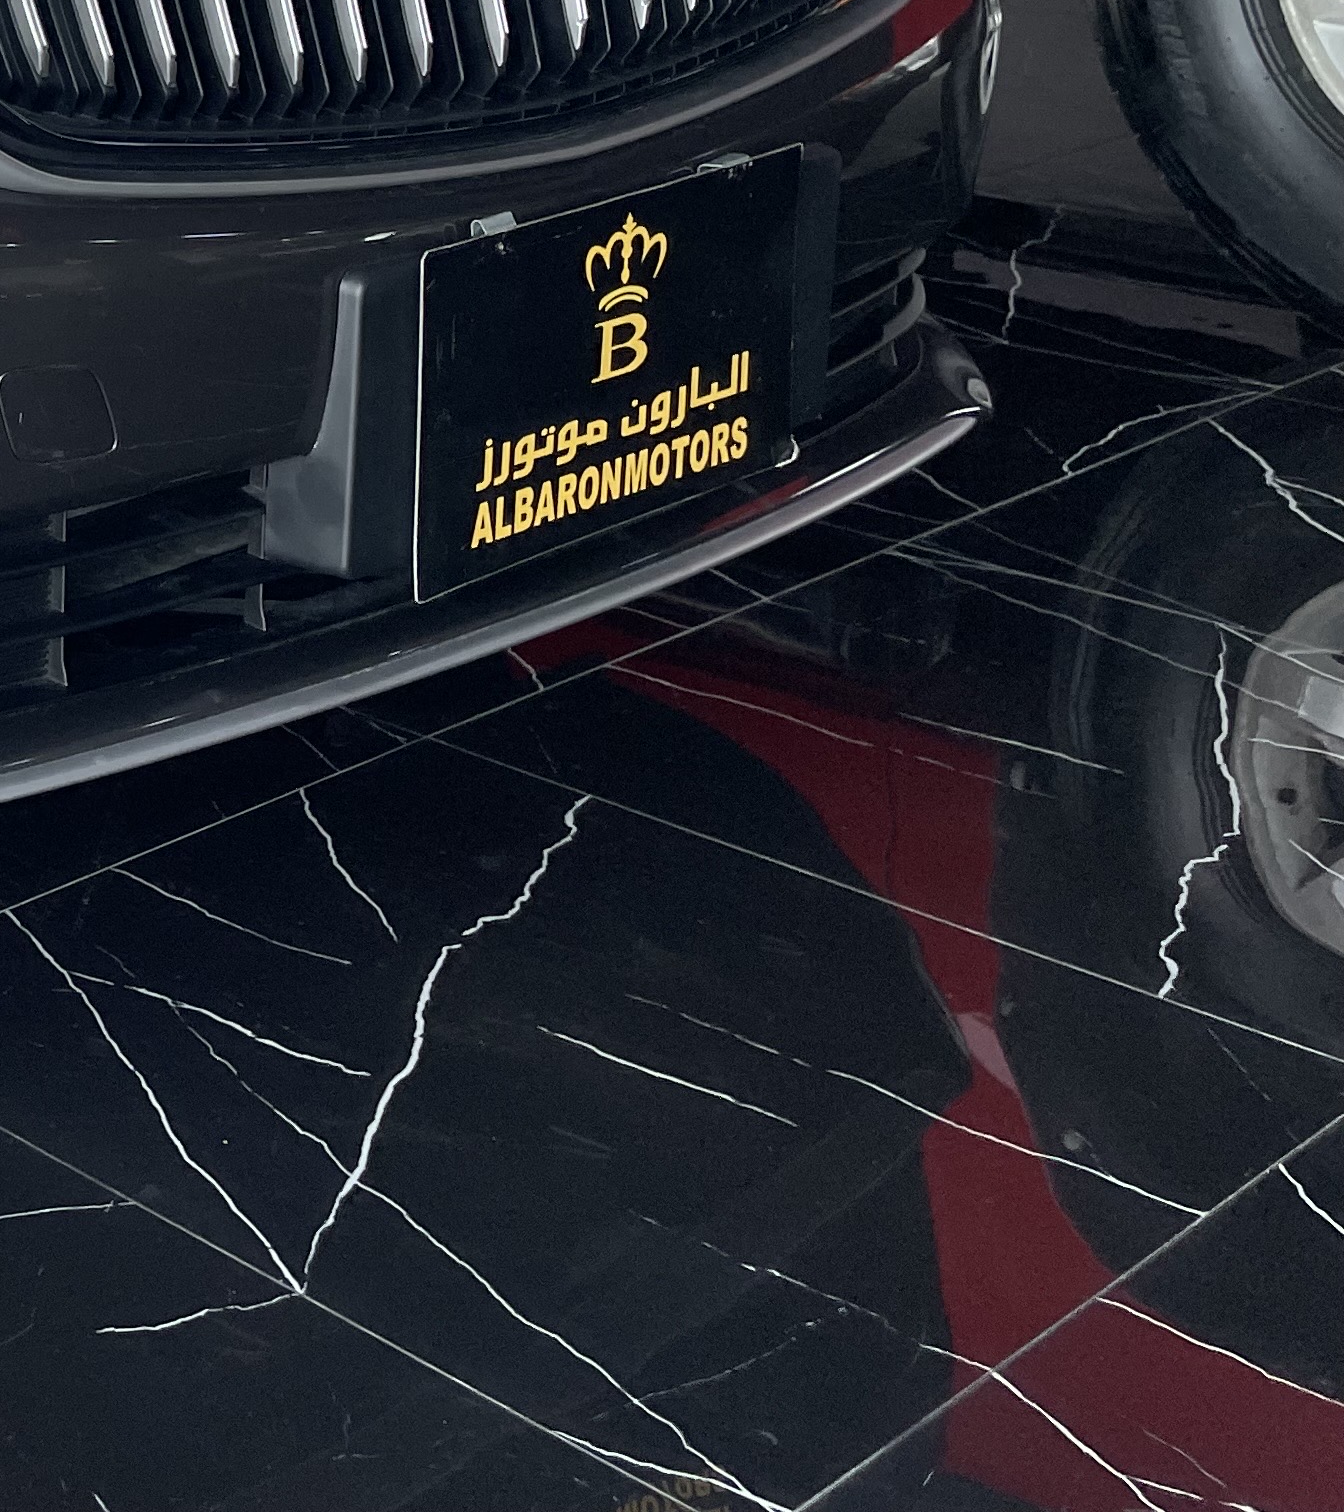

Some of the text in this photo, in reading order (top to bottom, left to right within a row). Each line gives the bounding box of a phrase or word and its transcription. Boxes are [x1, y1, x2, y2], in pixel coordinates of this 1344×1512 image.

[592, 312, 649, 383] B
[475, 350, 750, 493] البارون موتورز
